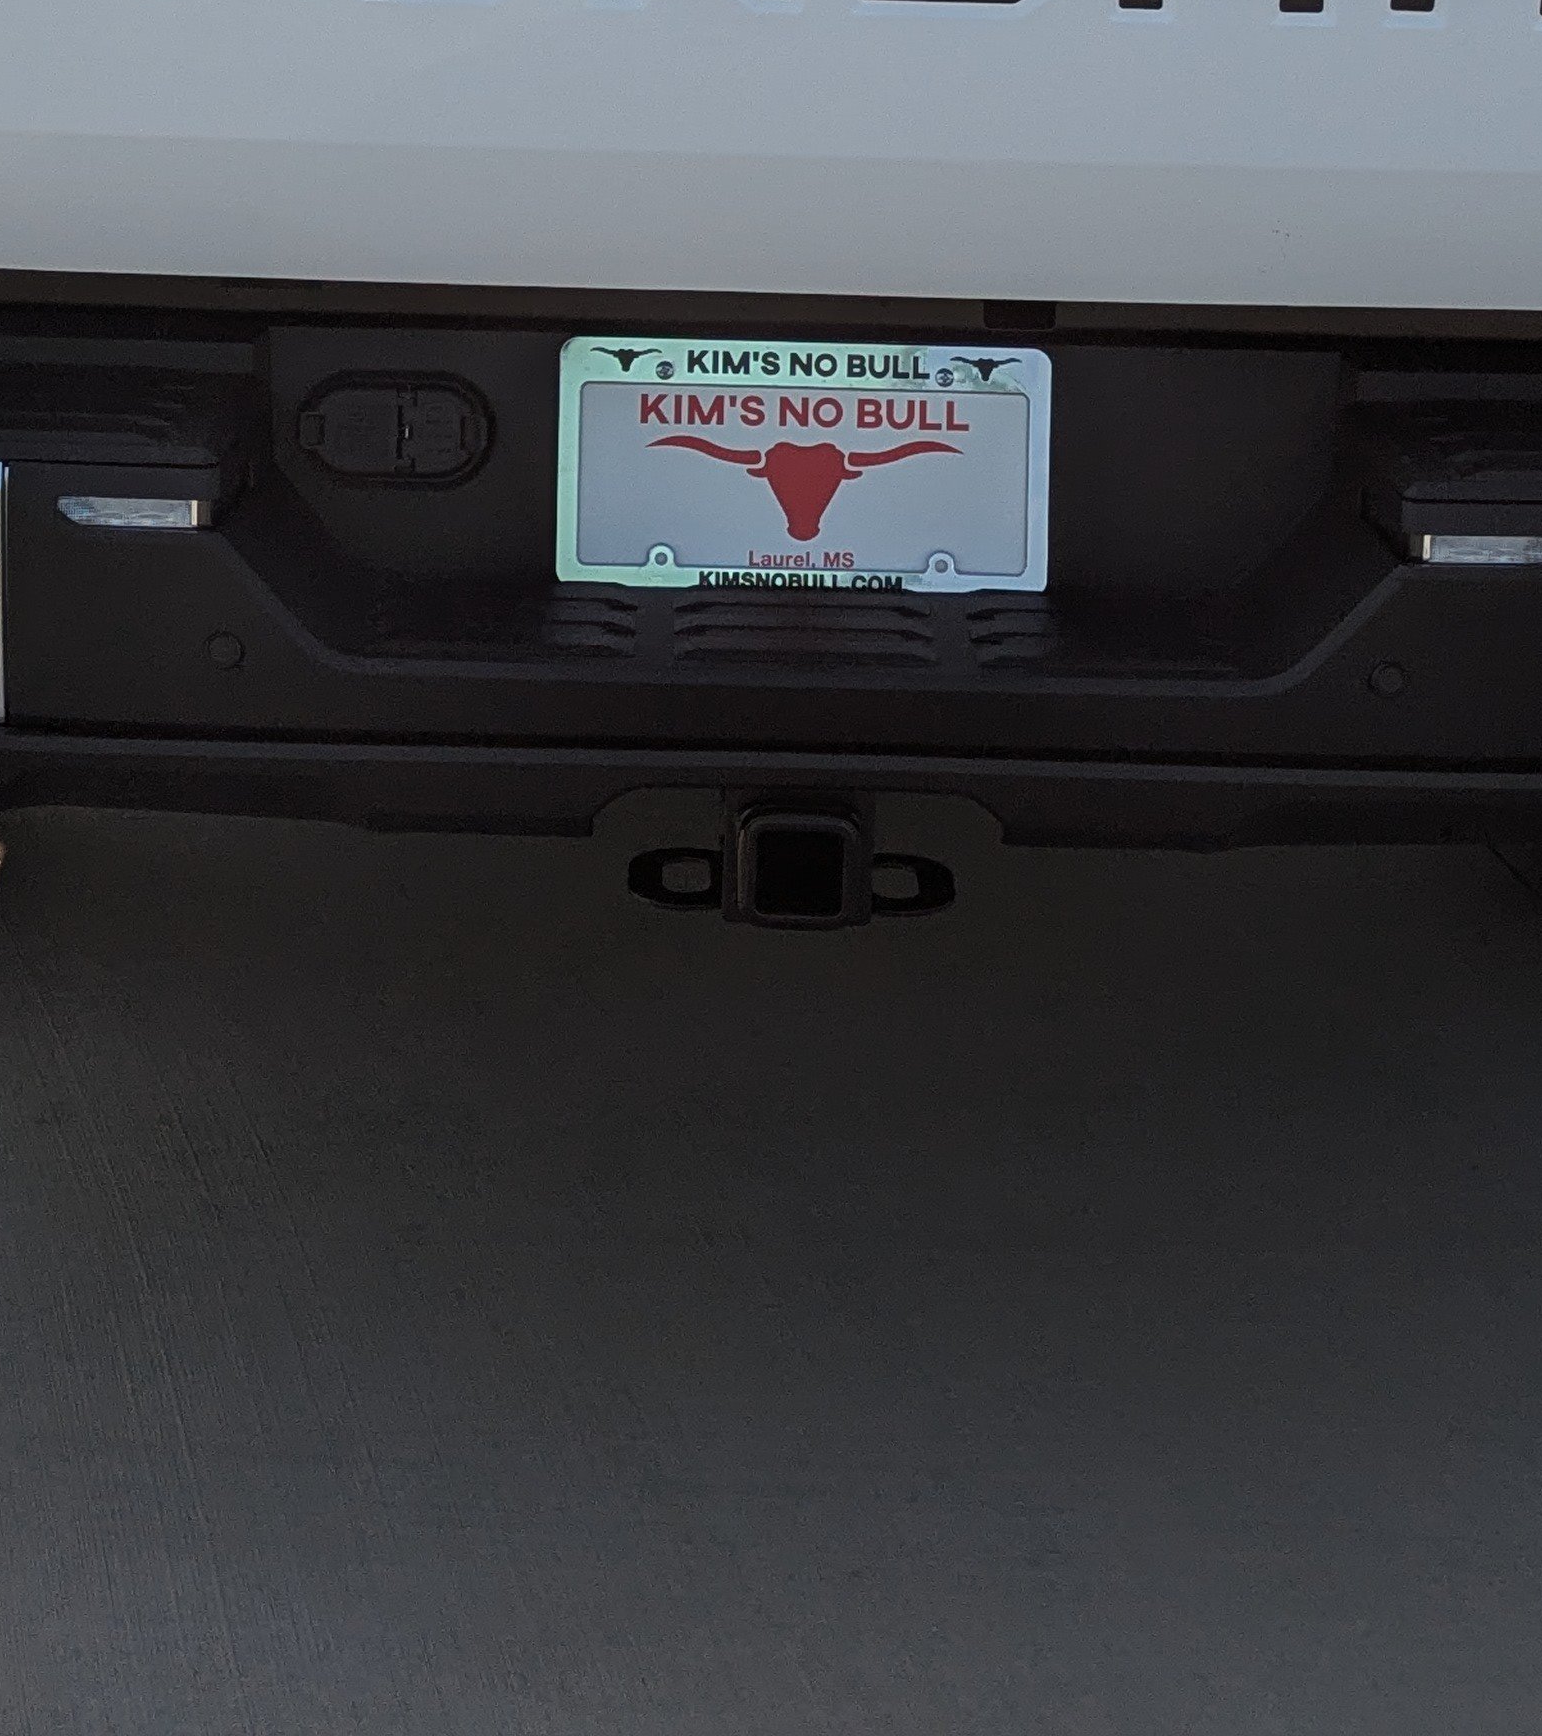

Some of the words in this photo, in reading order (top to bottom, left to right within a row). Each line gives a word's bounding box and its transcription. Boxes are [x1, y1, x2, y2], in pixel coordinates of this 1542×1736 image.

[686, 350, 782, 377] KIM'S
[789, 353, 838, 378] NO
[846, 355, 930, 381] BULL
[640, 394, 766, 427] KIM'S
[779, 396, 845, 428] NO
[857, 398, 970, 432] BULL
[823, 552, 855, 569] MS
[699, 571, 903, 592] KIMSNOBULL.COM
